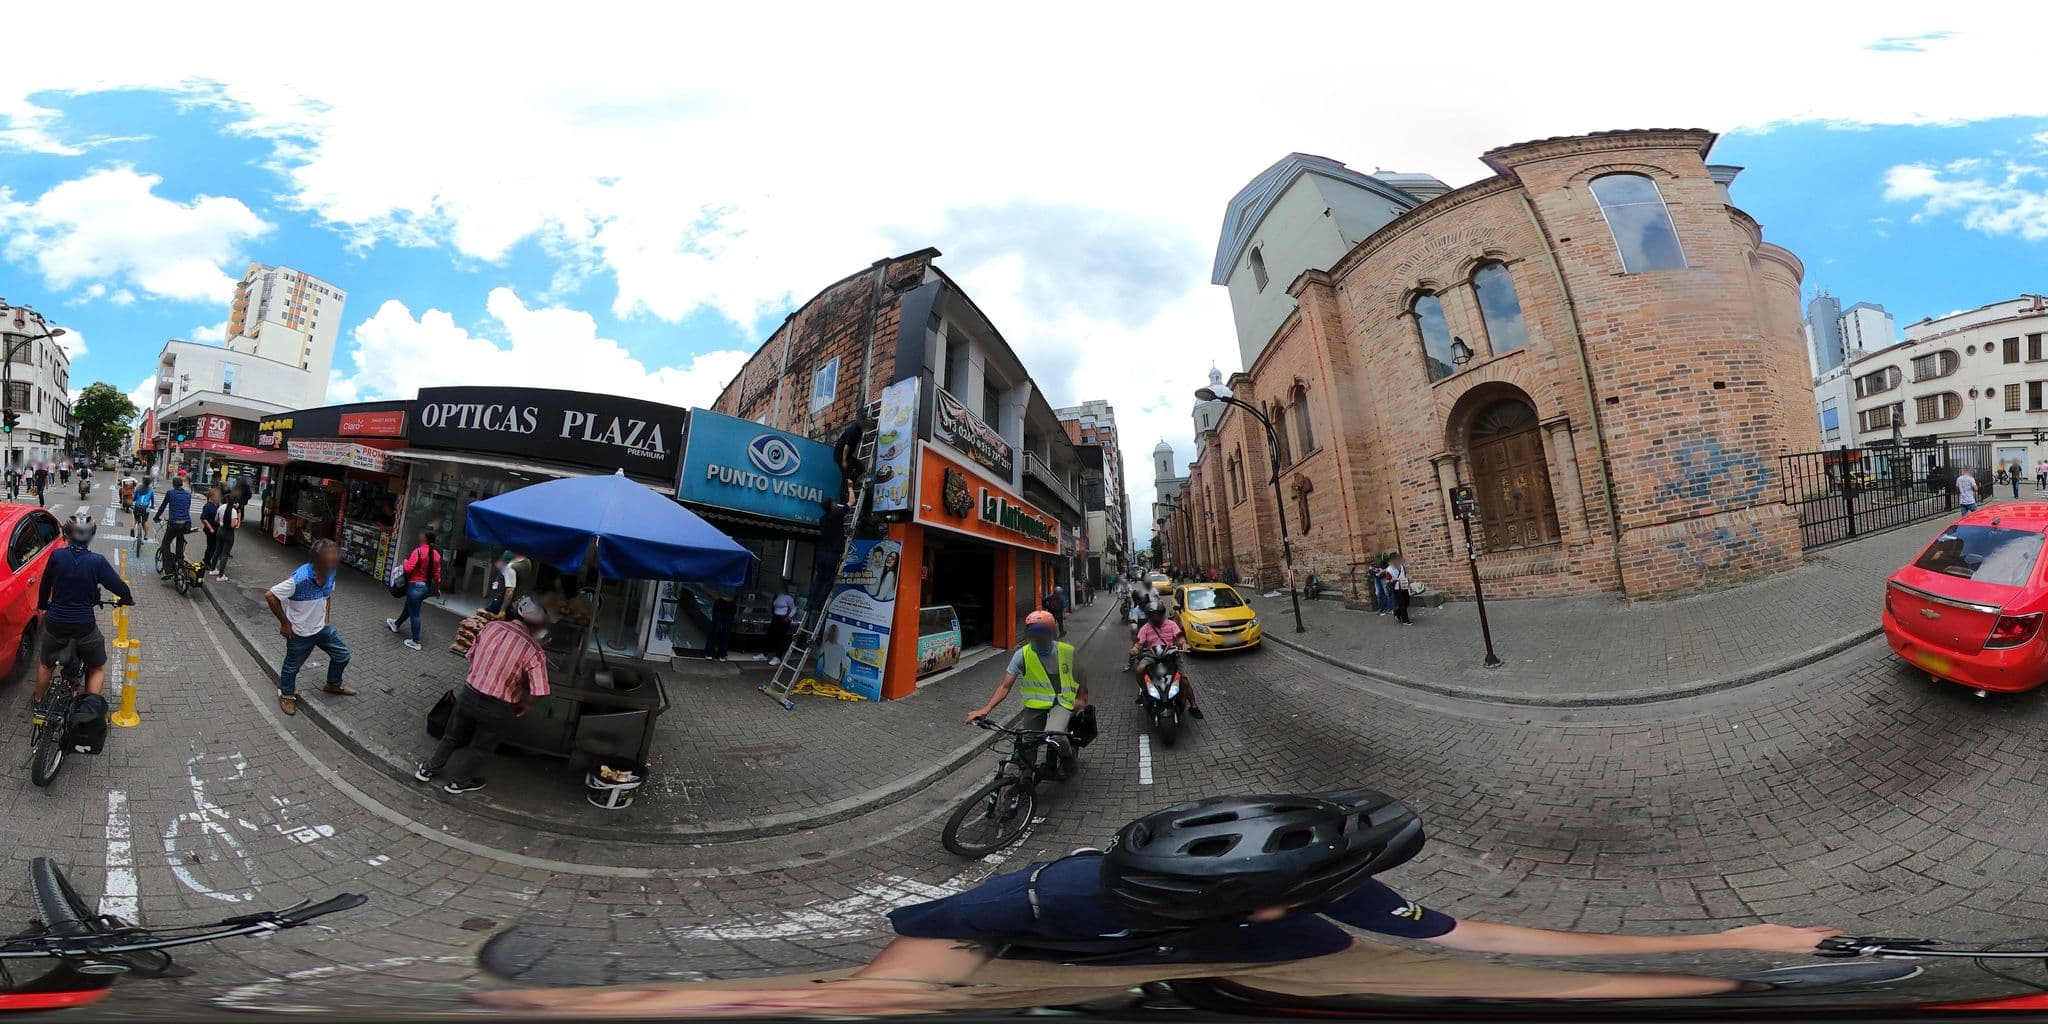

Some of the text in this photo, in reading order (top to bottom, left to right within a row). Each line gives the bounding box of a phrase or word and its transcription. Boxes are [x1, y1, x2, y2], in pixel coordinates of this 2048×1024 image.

[343, 421, 360, 431] Claro
[421, 403, 666, 454] OPTICAS PLAZA
[627, 447, 666, 460] PREMIUM
[706, 463, 769, 492] PUNTO
[978, 487, 998, 524] La
